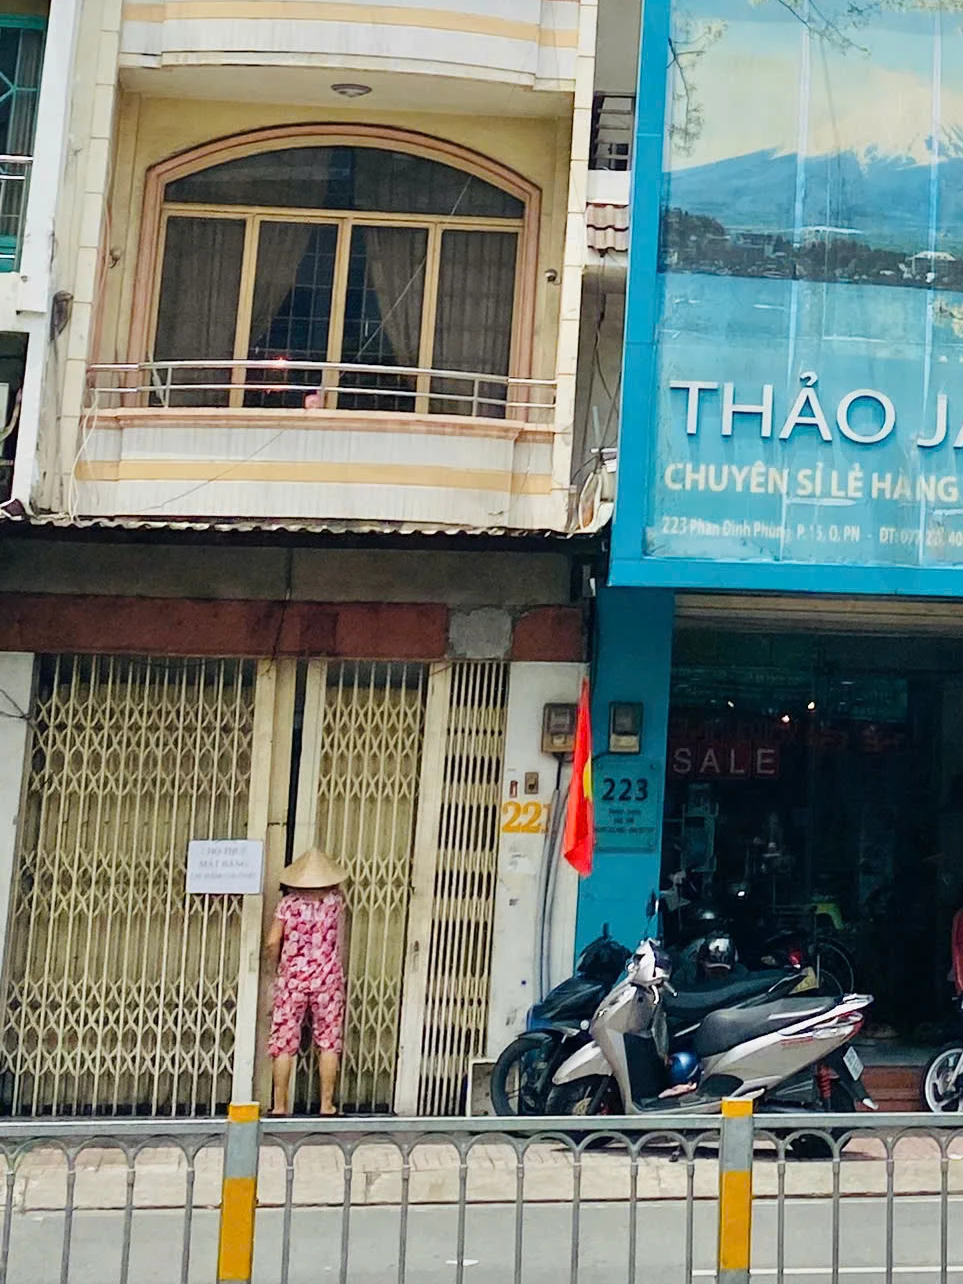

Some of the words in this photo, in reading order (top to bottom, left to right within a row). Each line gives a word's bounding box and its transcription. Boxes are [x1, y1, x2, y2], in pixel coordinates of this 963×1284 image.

[670, 371, 896, 445] THẢO
[664, 460, 787, 494] CHUYÊN
[672, 747, 776, 775] SALE
[602, 777, 648, 802] 223
